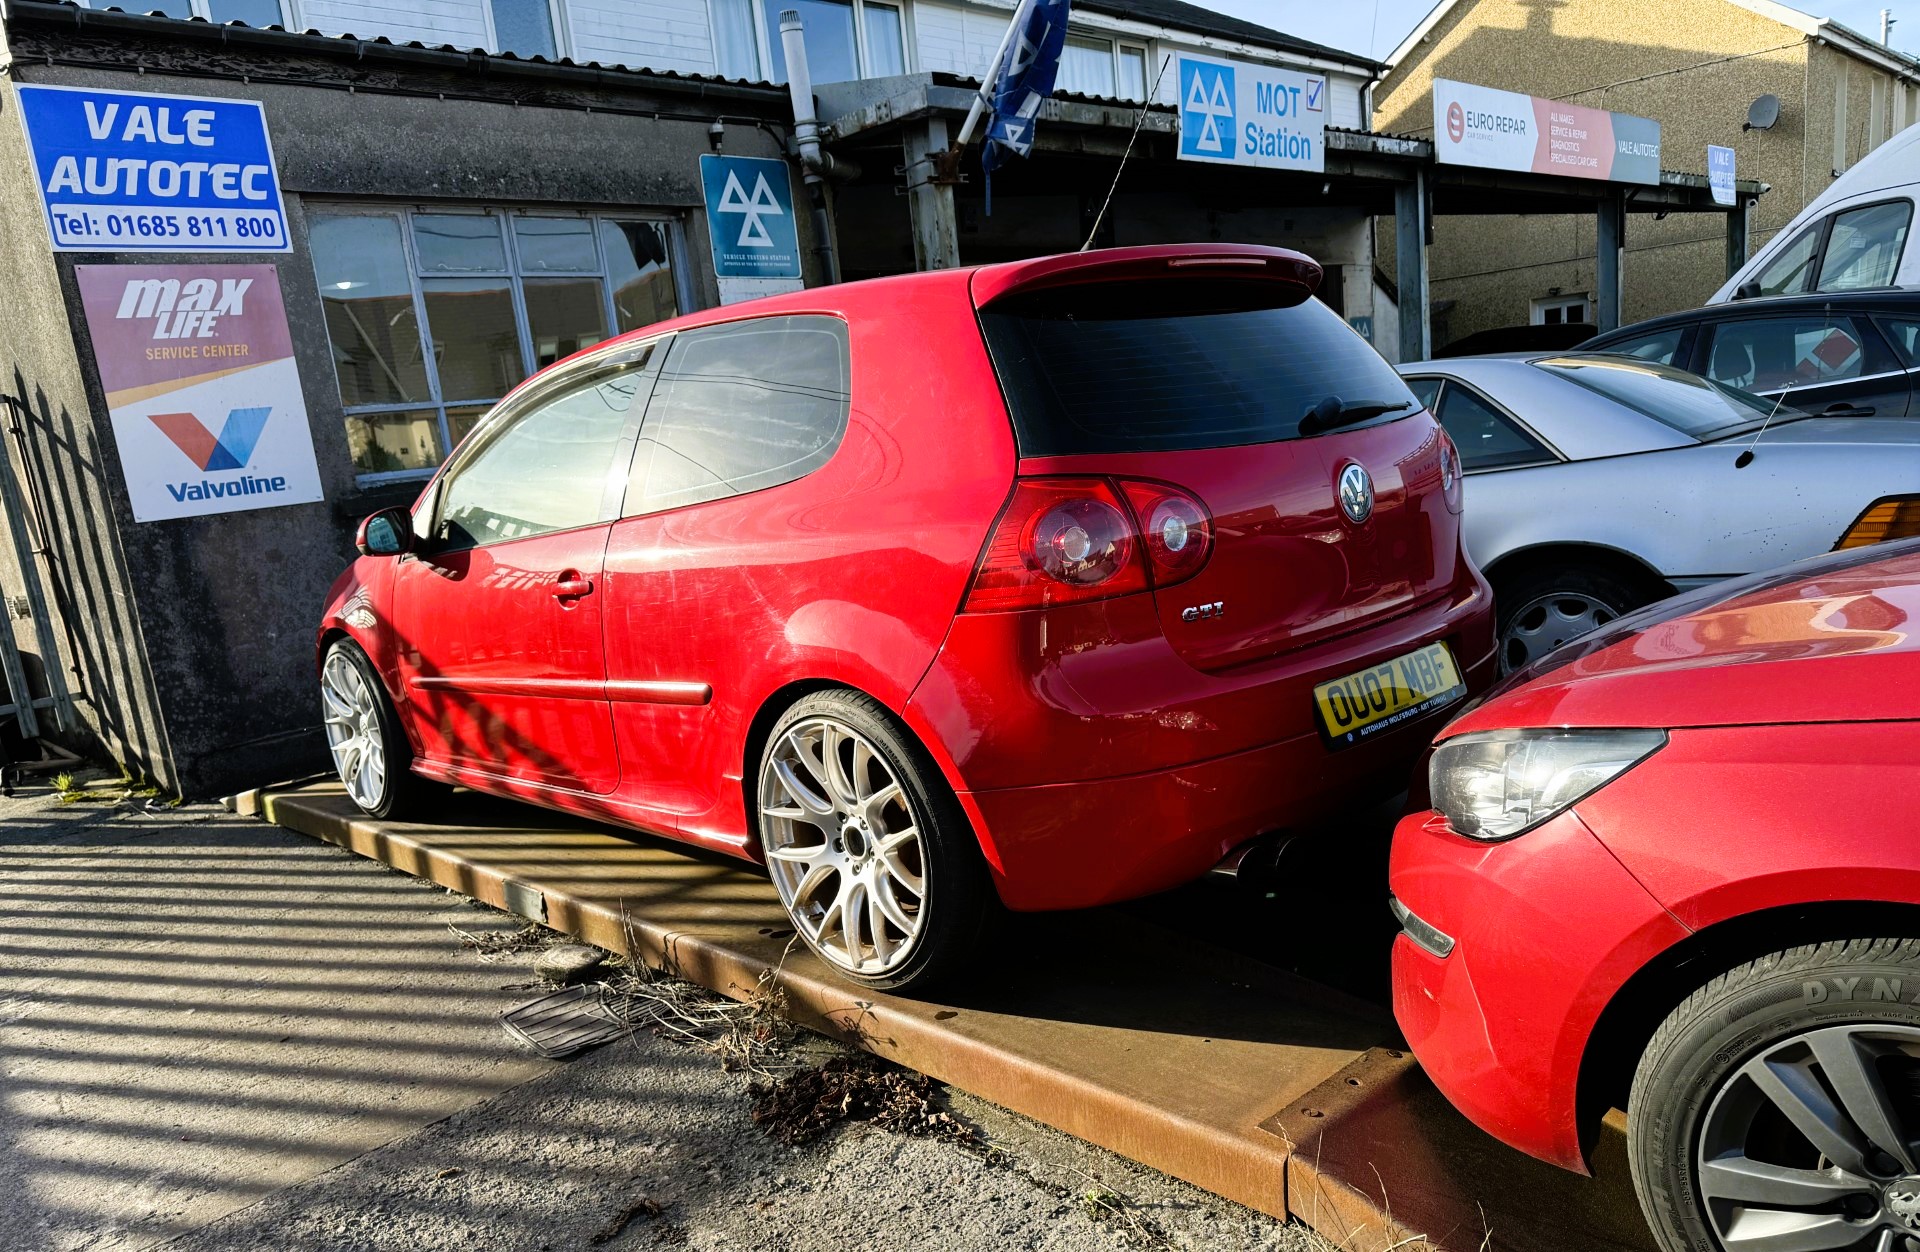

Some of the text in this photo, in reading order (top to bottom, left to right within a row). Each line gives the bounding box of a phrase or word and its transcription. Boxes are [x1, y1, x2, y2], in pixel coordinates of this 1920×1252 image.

[1257, 81, 1301, 118] MOT
[83, 101, 215, 146] VALE
[1466, 111, 1526, 136] EURO REPAR
[1550, 112, 1574, 125] ALL MAKES
[1245, 122, 1311, 160] Station
[1476, 133, 1494, 142] SERVICE
[1550, 126, 1588, 140] SERVICE & REPAIR
[1550, 140, 1580, 152] DIAGNOSTICS
[1618, 140, 1659, 158] VALE AUTOTEC
[1714, 150, 1730, 167] VALE
[1550, 153, 1598, 168] SPECIALISED CAR CARE
[47, 155, 269, 201] AUTOTEC
[54, 212, 276, 238] Tel: 01685 811 800
[152, 310, 222, 340] LIFE
[145, 344, 249, 361] SERVICE CENTER
[166, 476, 286, 502] Valvoline
[1182, 601, 1224, 621] GTI
[1327, 646, 1445, 727] OU07 MBF
[1360, 720, 1389, 736] AUTOHAUS
[1388, 707, 1418, 725] WOLFSBURG
